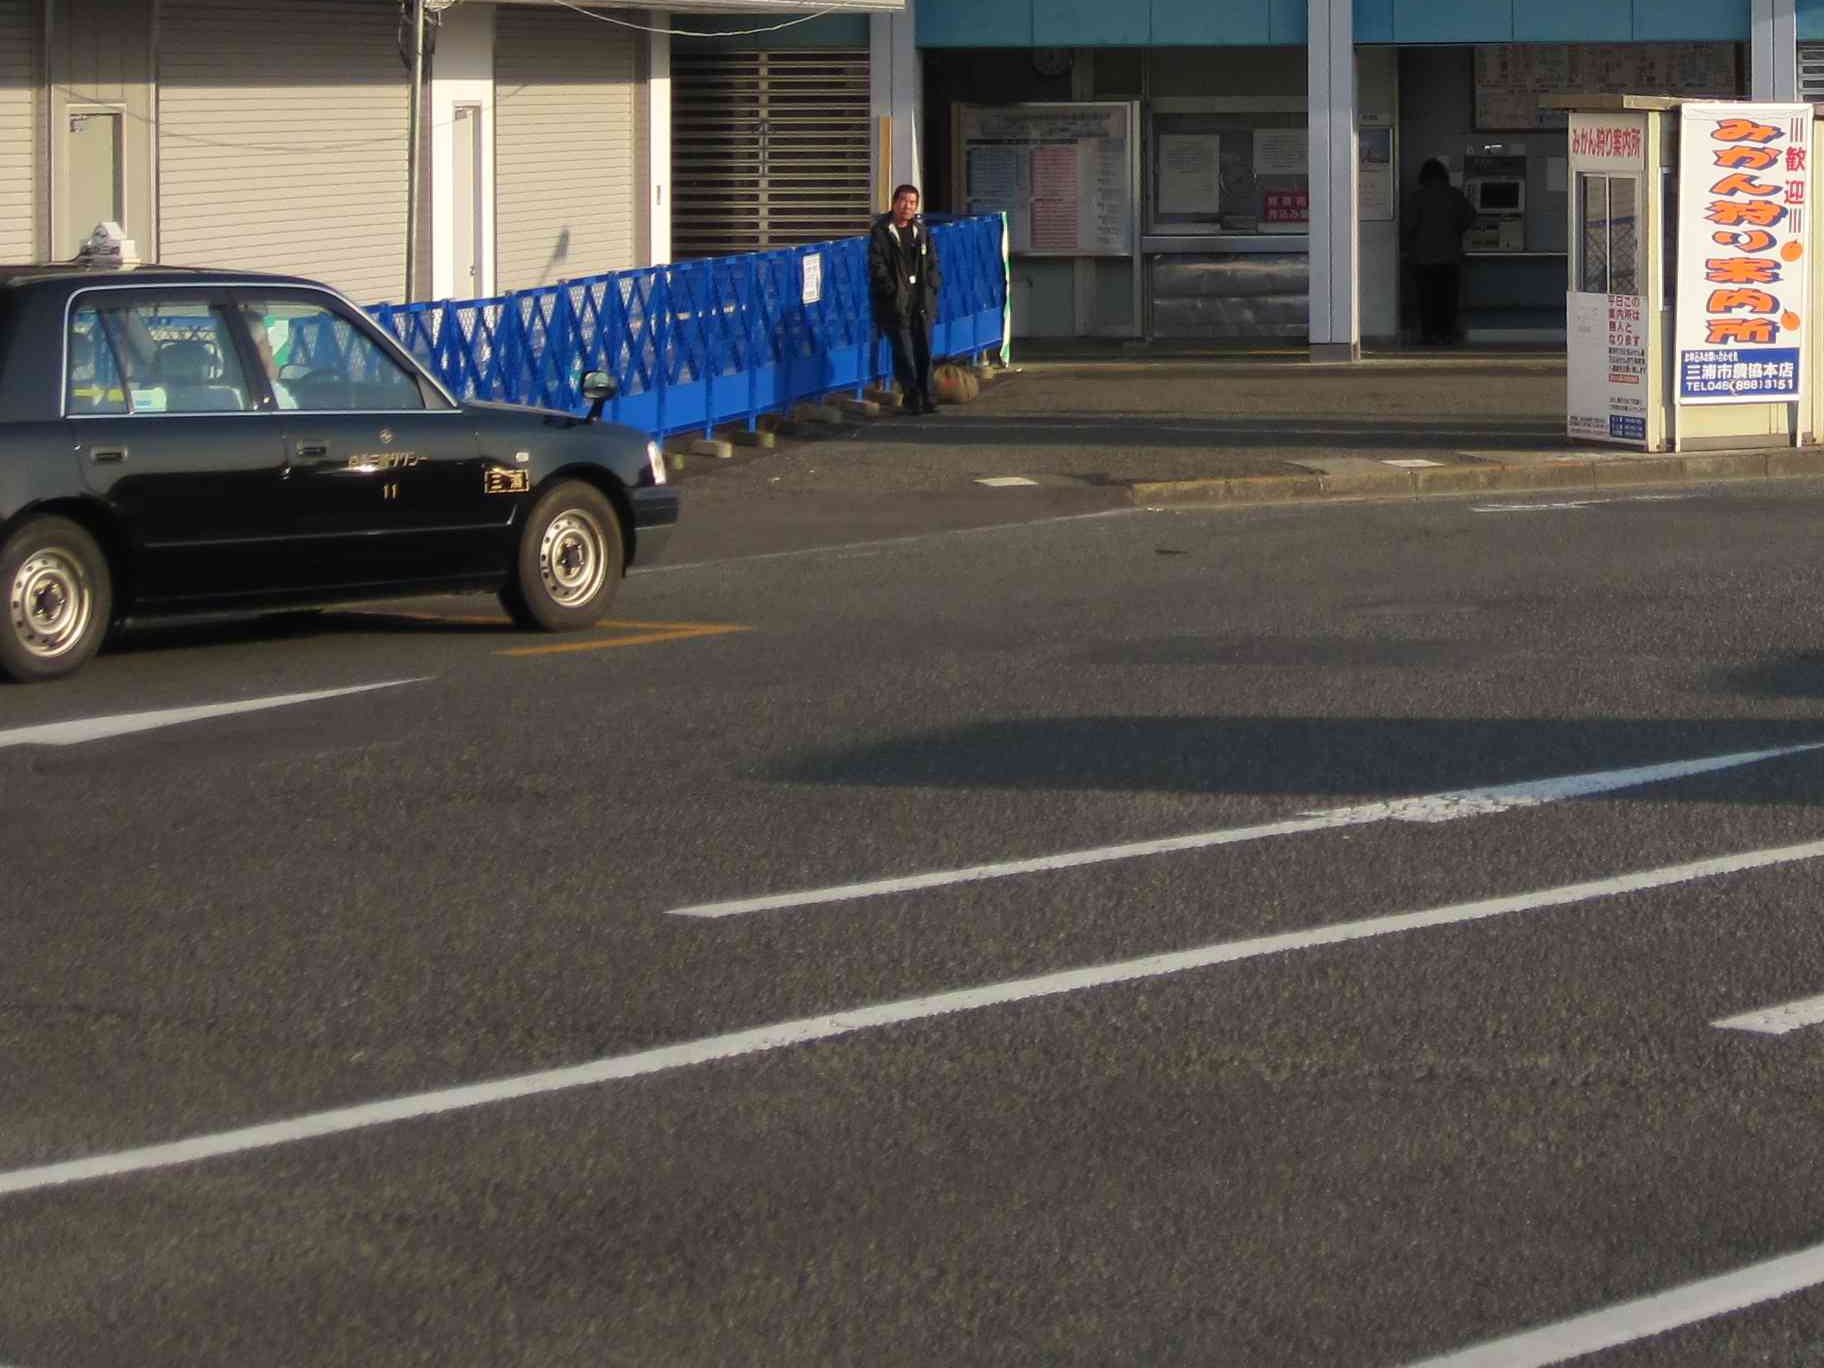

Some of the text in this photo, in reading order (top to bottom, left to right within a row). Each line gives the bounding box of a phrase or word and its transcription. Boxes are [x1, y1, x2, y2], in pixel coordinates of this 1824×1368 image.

[1784, 145, 1806, 206] 歓迎
[1686, 362, 1794, 380] 三浦市農協本店
